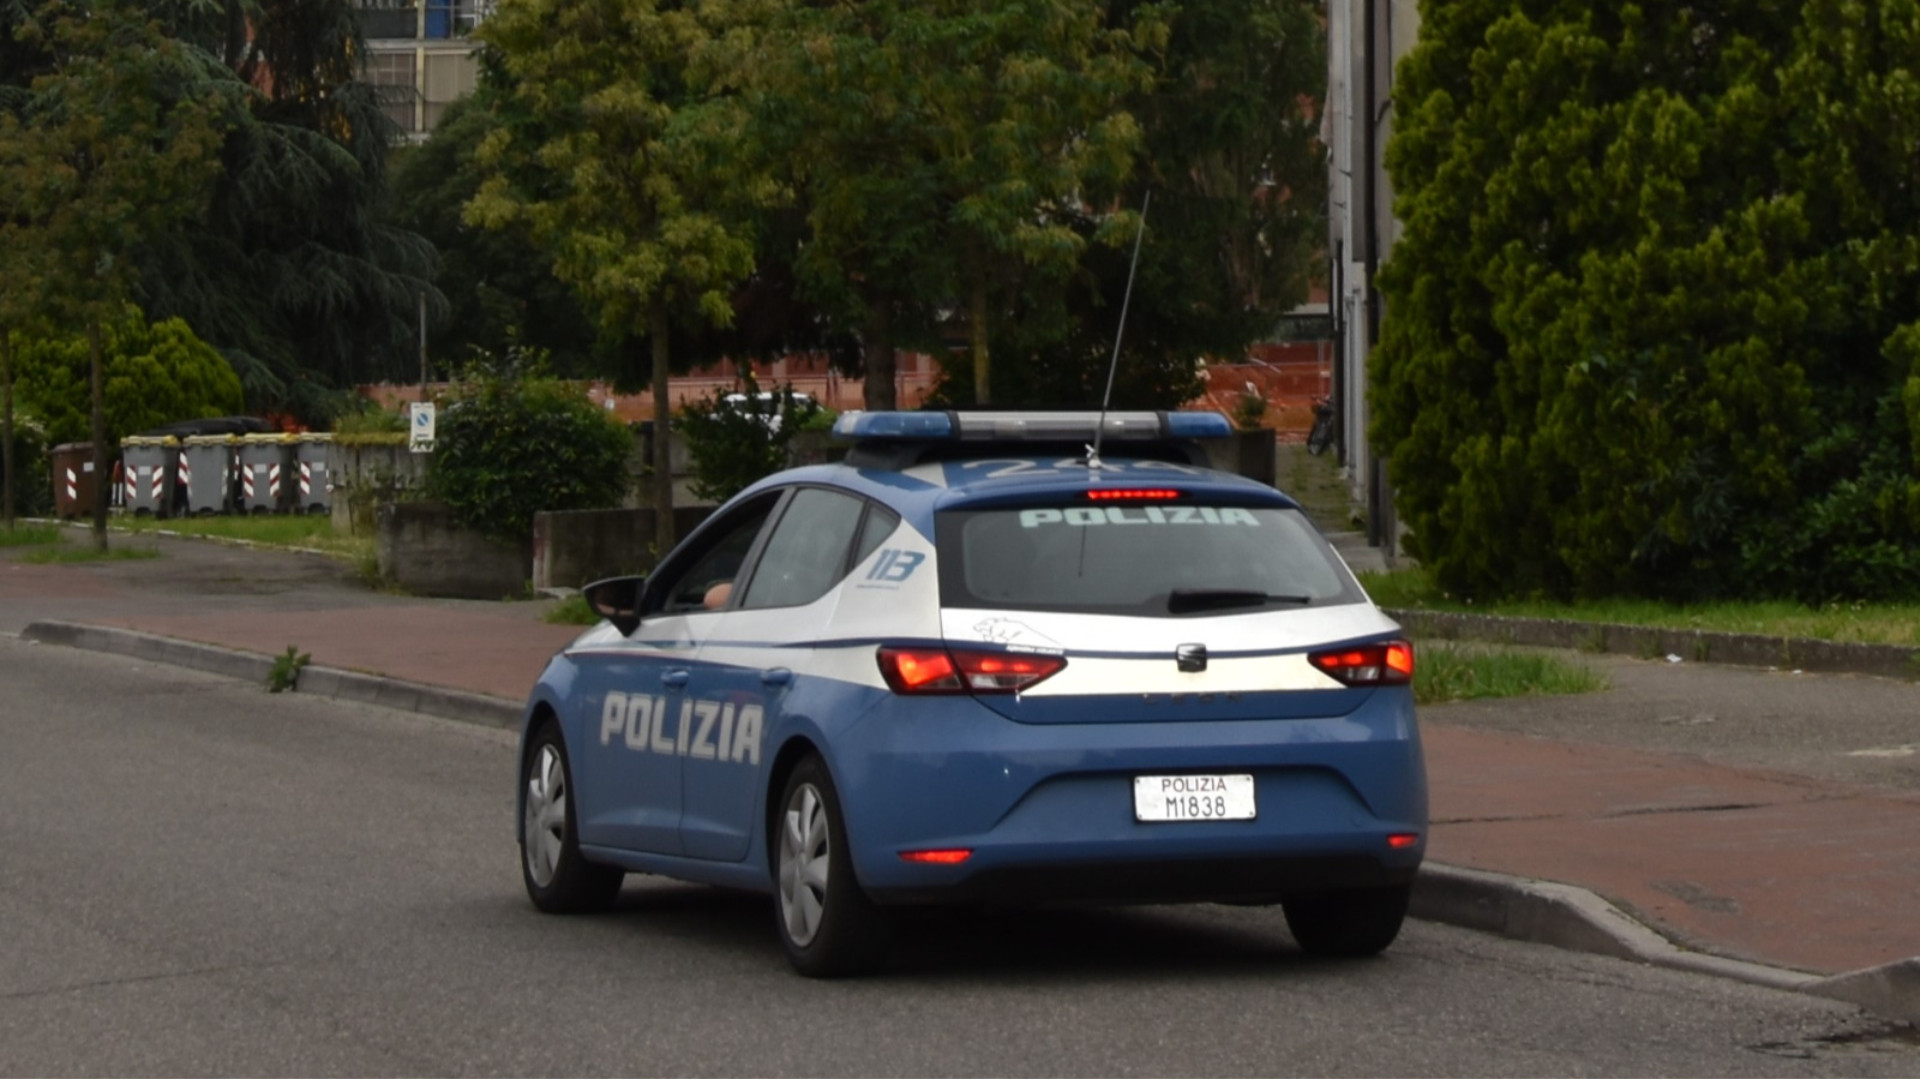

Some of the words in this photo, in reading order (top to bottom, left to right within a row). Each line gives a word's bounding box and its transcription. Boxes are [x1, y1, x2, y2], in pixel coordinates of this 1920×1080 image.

[1019, 506, 1260, 527] POLIZIA
[866, 549, 925, 582] 113
[601, 690, 764, 765] POLIZIA
[1162, 777, 1227, 792] POLIZIA
[1166, 796, 1226, 817] M1838
